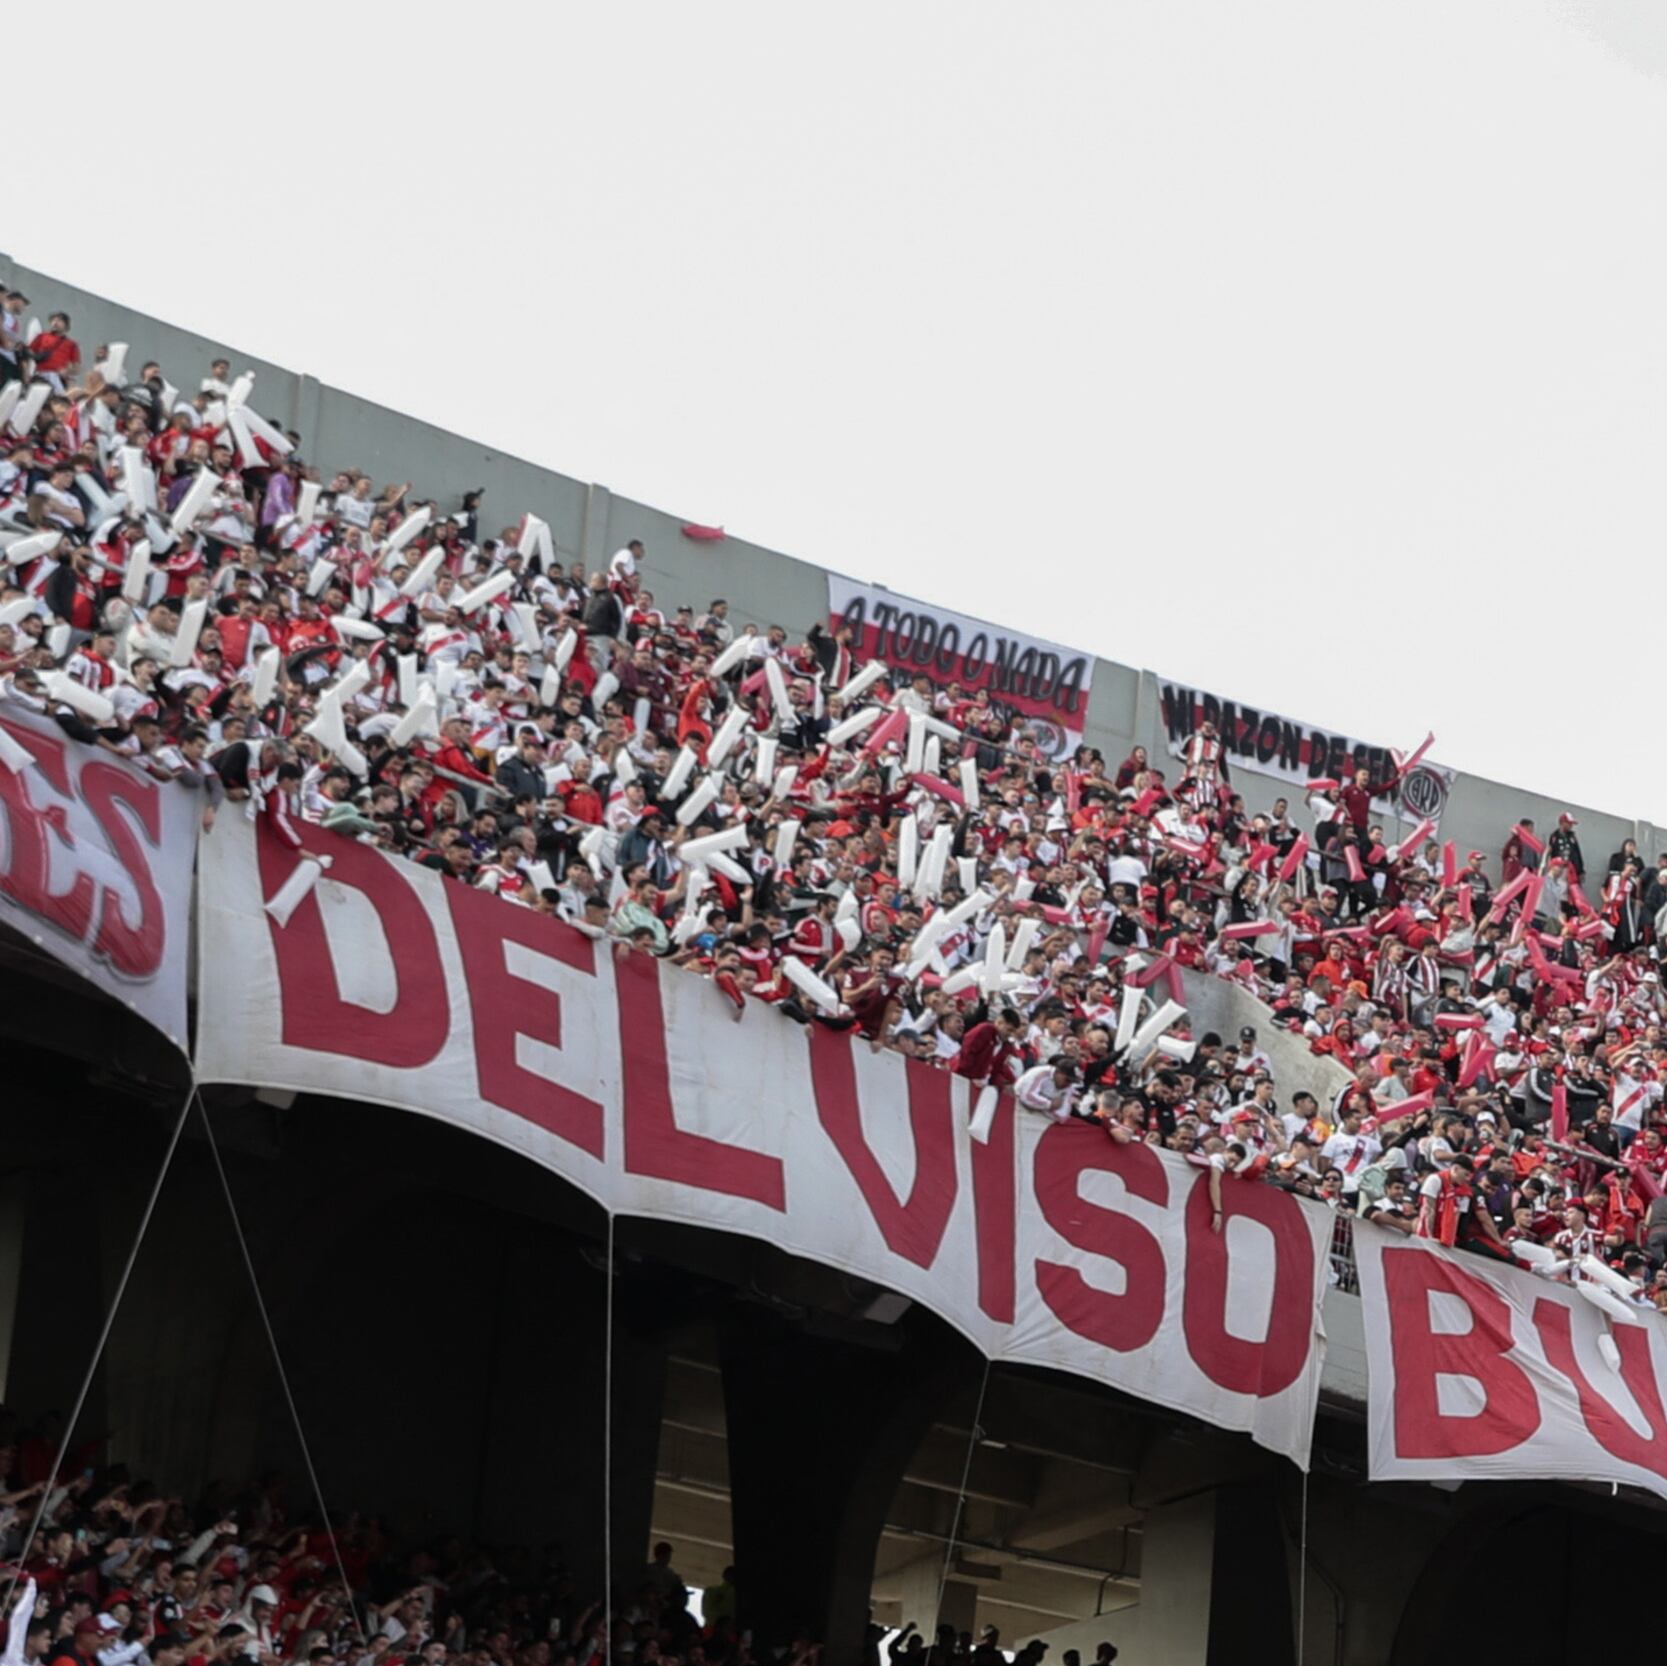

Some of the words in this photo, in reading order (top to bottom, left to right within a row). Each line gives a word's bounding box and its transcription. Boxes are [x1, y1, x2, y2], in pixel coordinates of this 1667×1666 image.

[874, 603, 961, 674] TODO
[963, 632, 988, 681] O
[991, 637, 1088, 714] NADA
[255, 814, 786, 1214] DEL
[810, 1021, 1314, 1399] VISO
